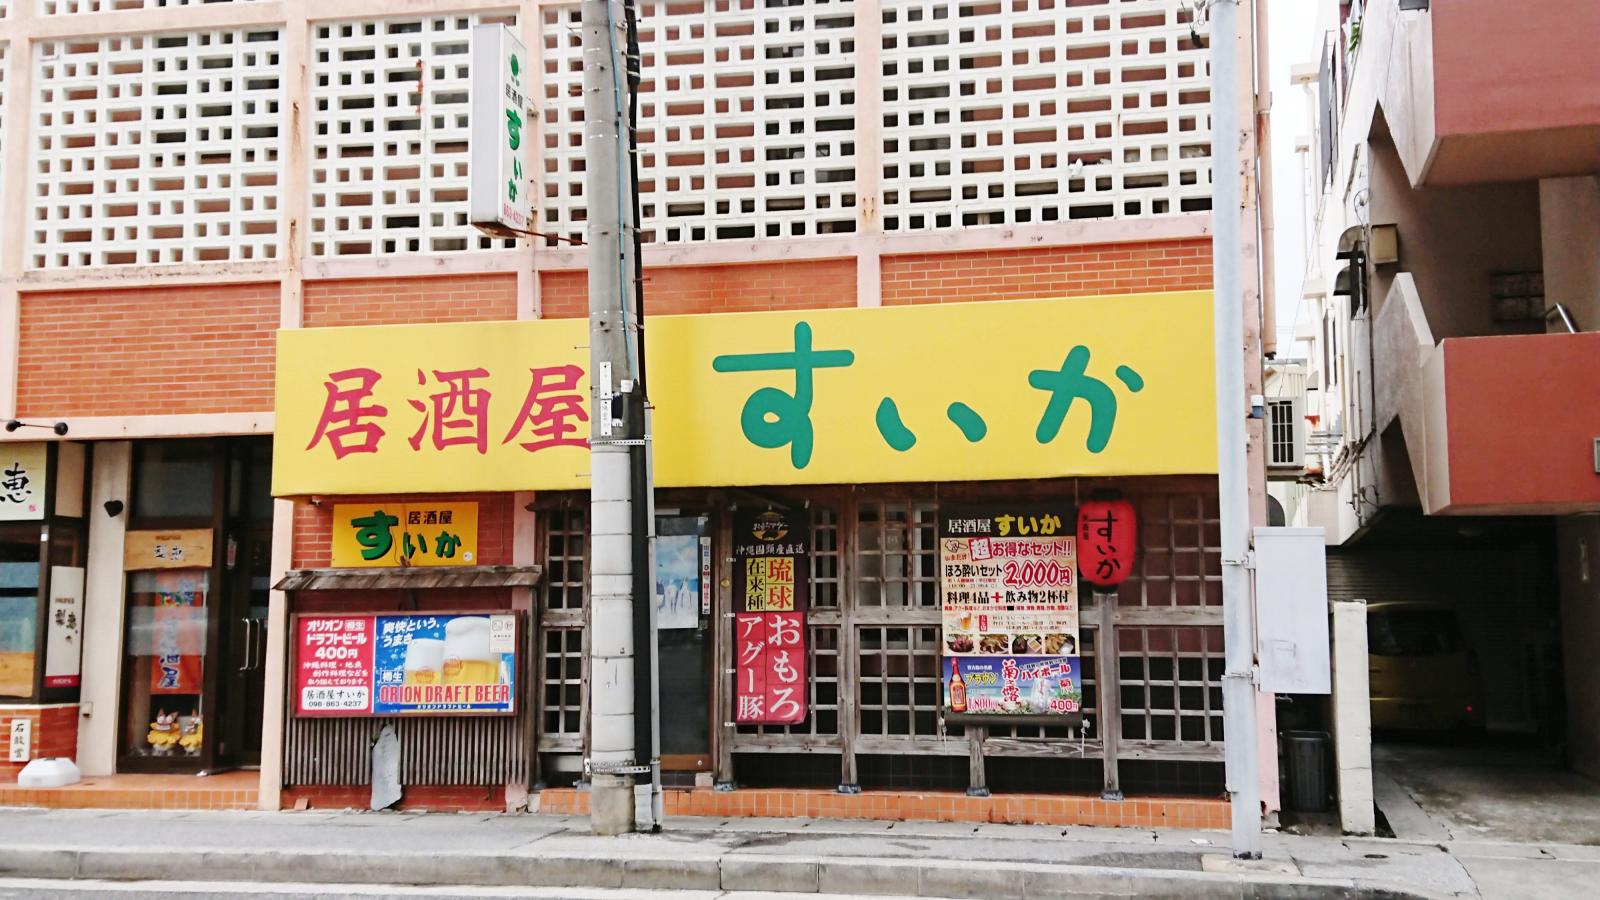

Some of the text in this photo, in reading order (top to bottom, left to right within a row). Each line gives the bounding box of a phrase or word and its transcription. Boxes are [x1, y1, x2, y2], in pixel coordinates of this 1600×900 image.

[506, 107, 523, 203] すいか
[305, 321, 1144, 469] 居酒屋 すいか
[408, 510, 453, 525] 居酒屋
[948, 518, 992, 533] 居酒屋
[994, 513, 1062, 537] すいか
[350, 510, 462, 561] すいか
[1086, 509, 1121, 580] すいか
[736, 542, 805, 556] 沖縄国頭産直送
[945, 560, 1072, 588] ほろ酔いセット 2,000円
[747, 558, 765, 611] 在来種
[766, 558, 793, 610] 琉球
[306, 619, 343, 632] オリオン
[306, 632, 367, 646] ドラフトビール
[315, 646, 358, 660] 400円
[738, 616, 766, 720] アグー豚
[768, 614, 801, 719] おもろ
[1021, 663, 1071, 681] ハイボール
[383, 671, 403, 682] 樽生
[964, 672, 998, 686] ブラウン
[307, 689, 365, 700] 居酒屋すいか
[380, 684, 510, 703] ORION DRAFT BEER
[1050, 700, 1078, 712] 400円
